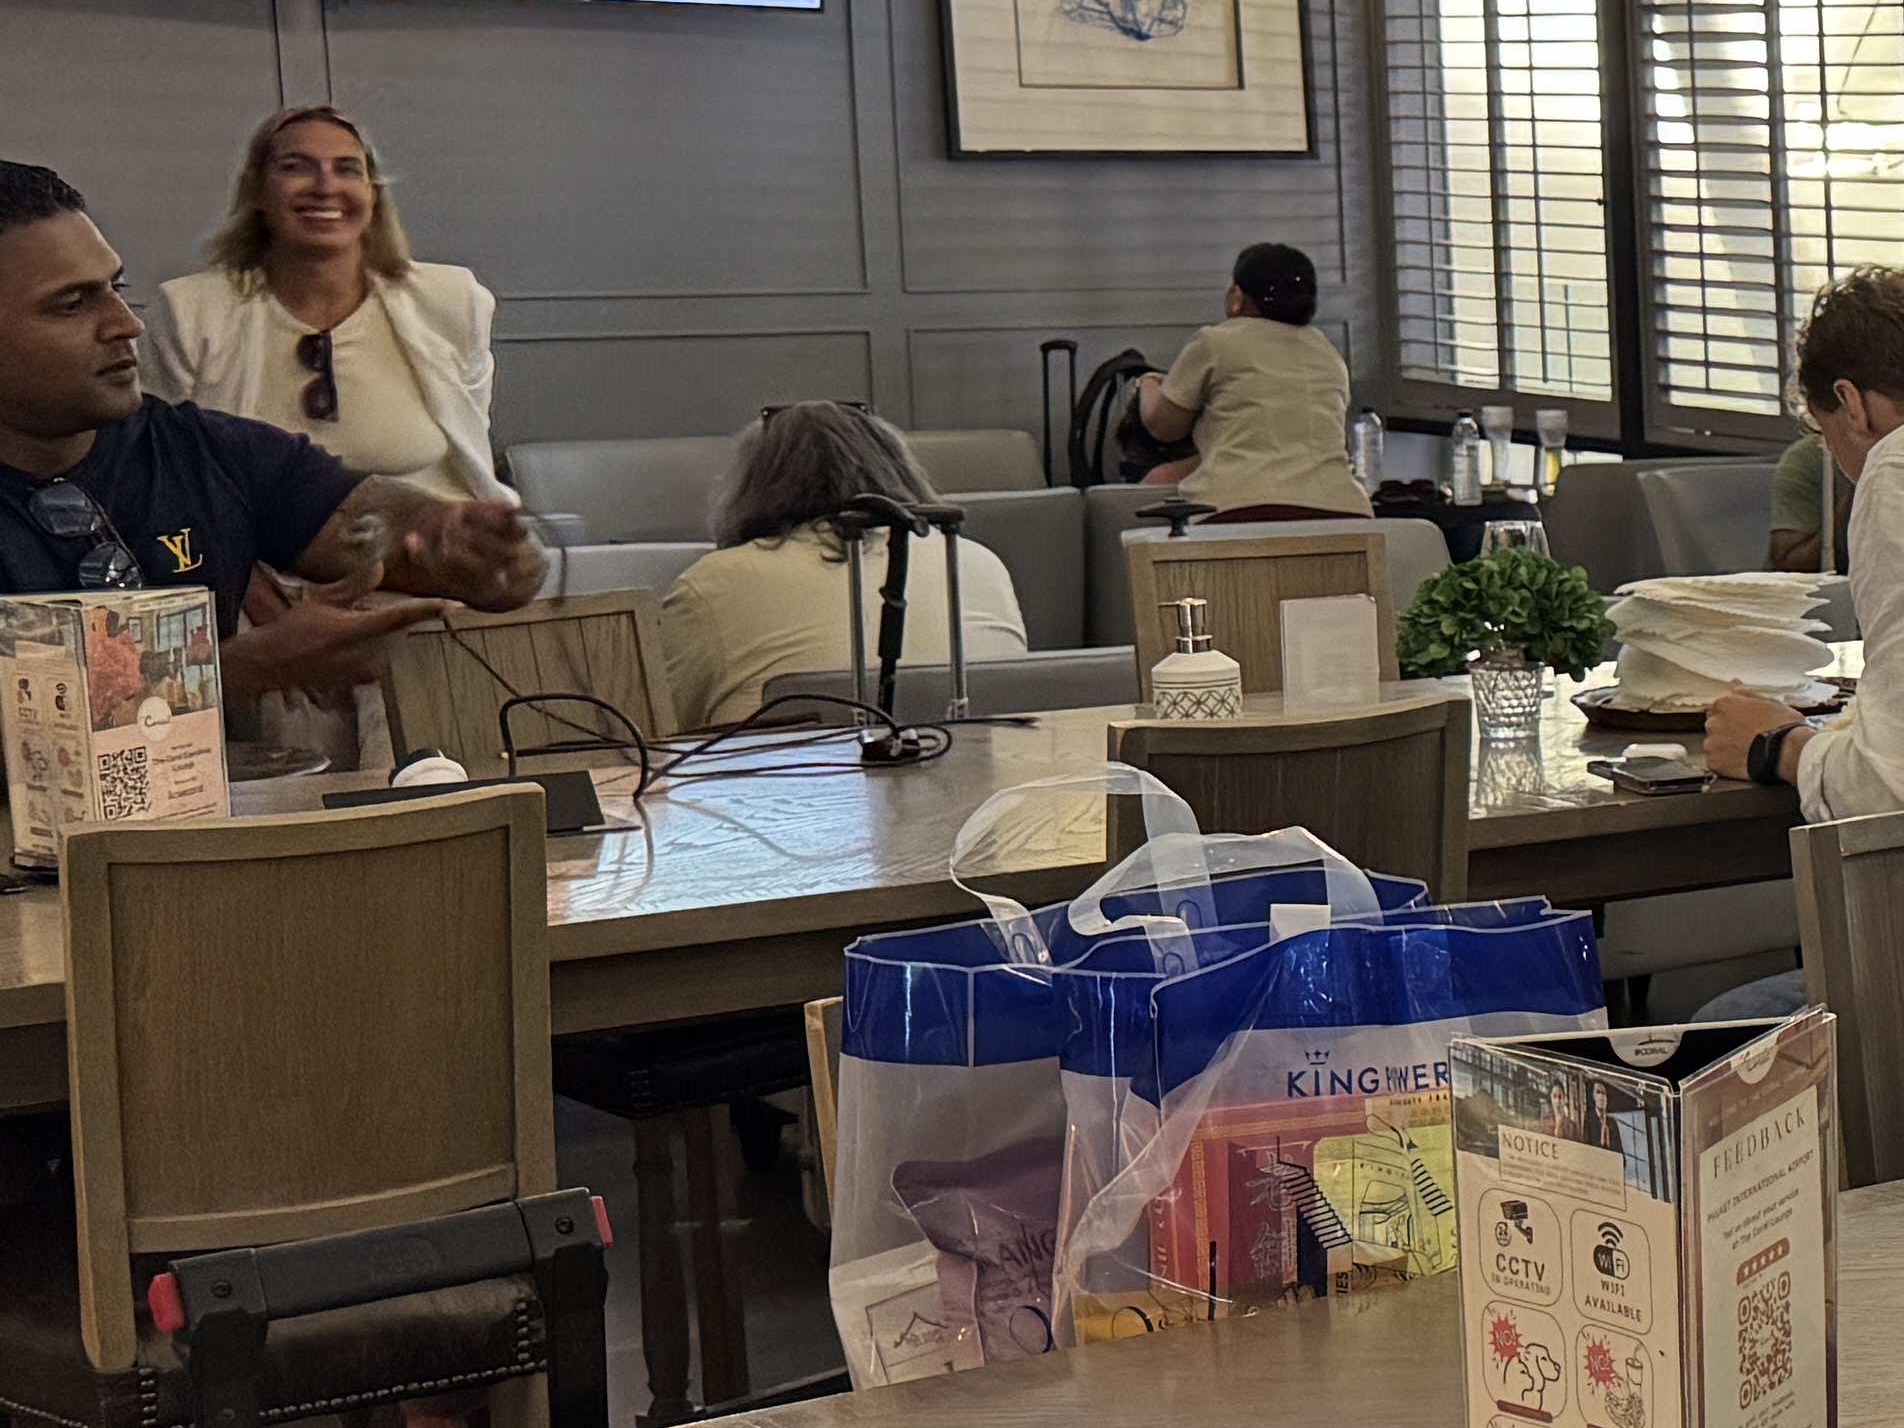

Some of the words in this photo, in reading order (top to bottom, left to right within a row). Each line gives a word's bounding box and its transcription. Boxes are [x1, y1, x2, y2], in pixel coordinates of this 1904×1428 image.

[1287, 1067, 1380, 1098] KING
[1502, 1132, 1559, 1160] NOTICE
[1713, 1107, 1805, 1179] FEEDBACK
[1496, 1253, 1546, 1282] CCTV
[1601, 1280, 1626, 1298] WIFI
[1584, 1294, 1643, 1323] AVAILABLE
